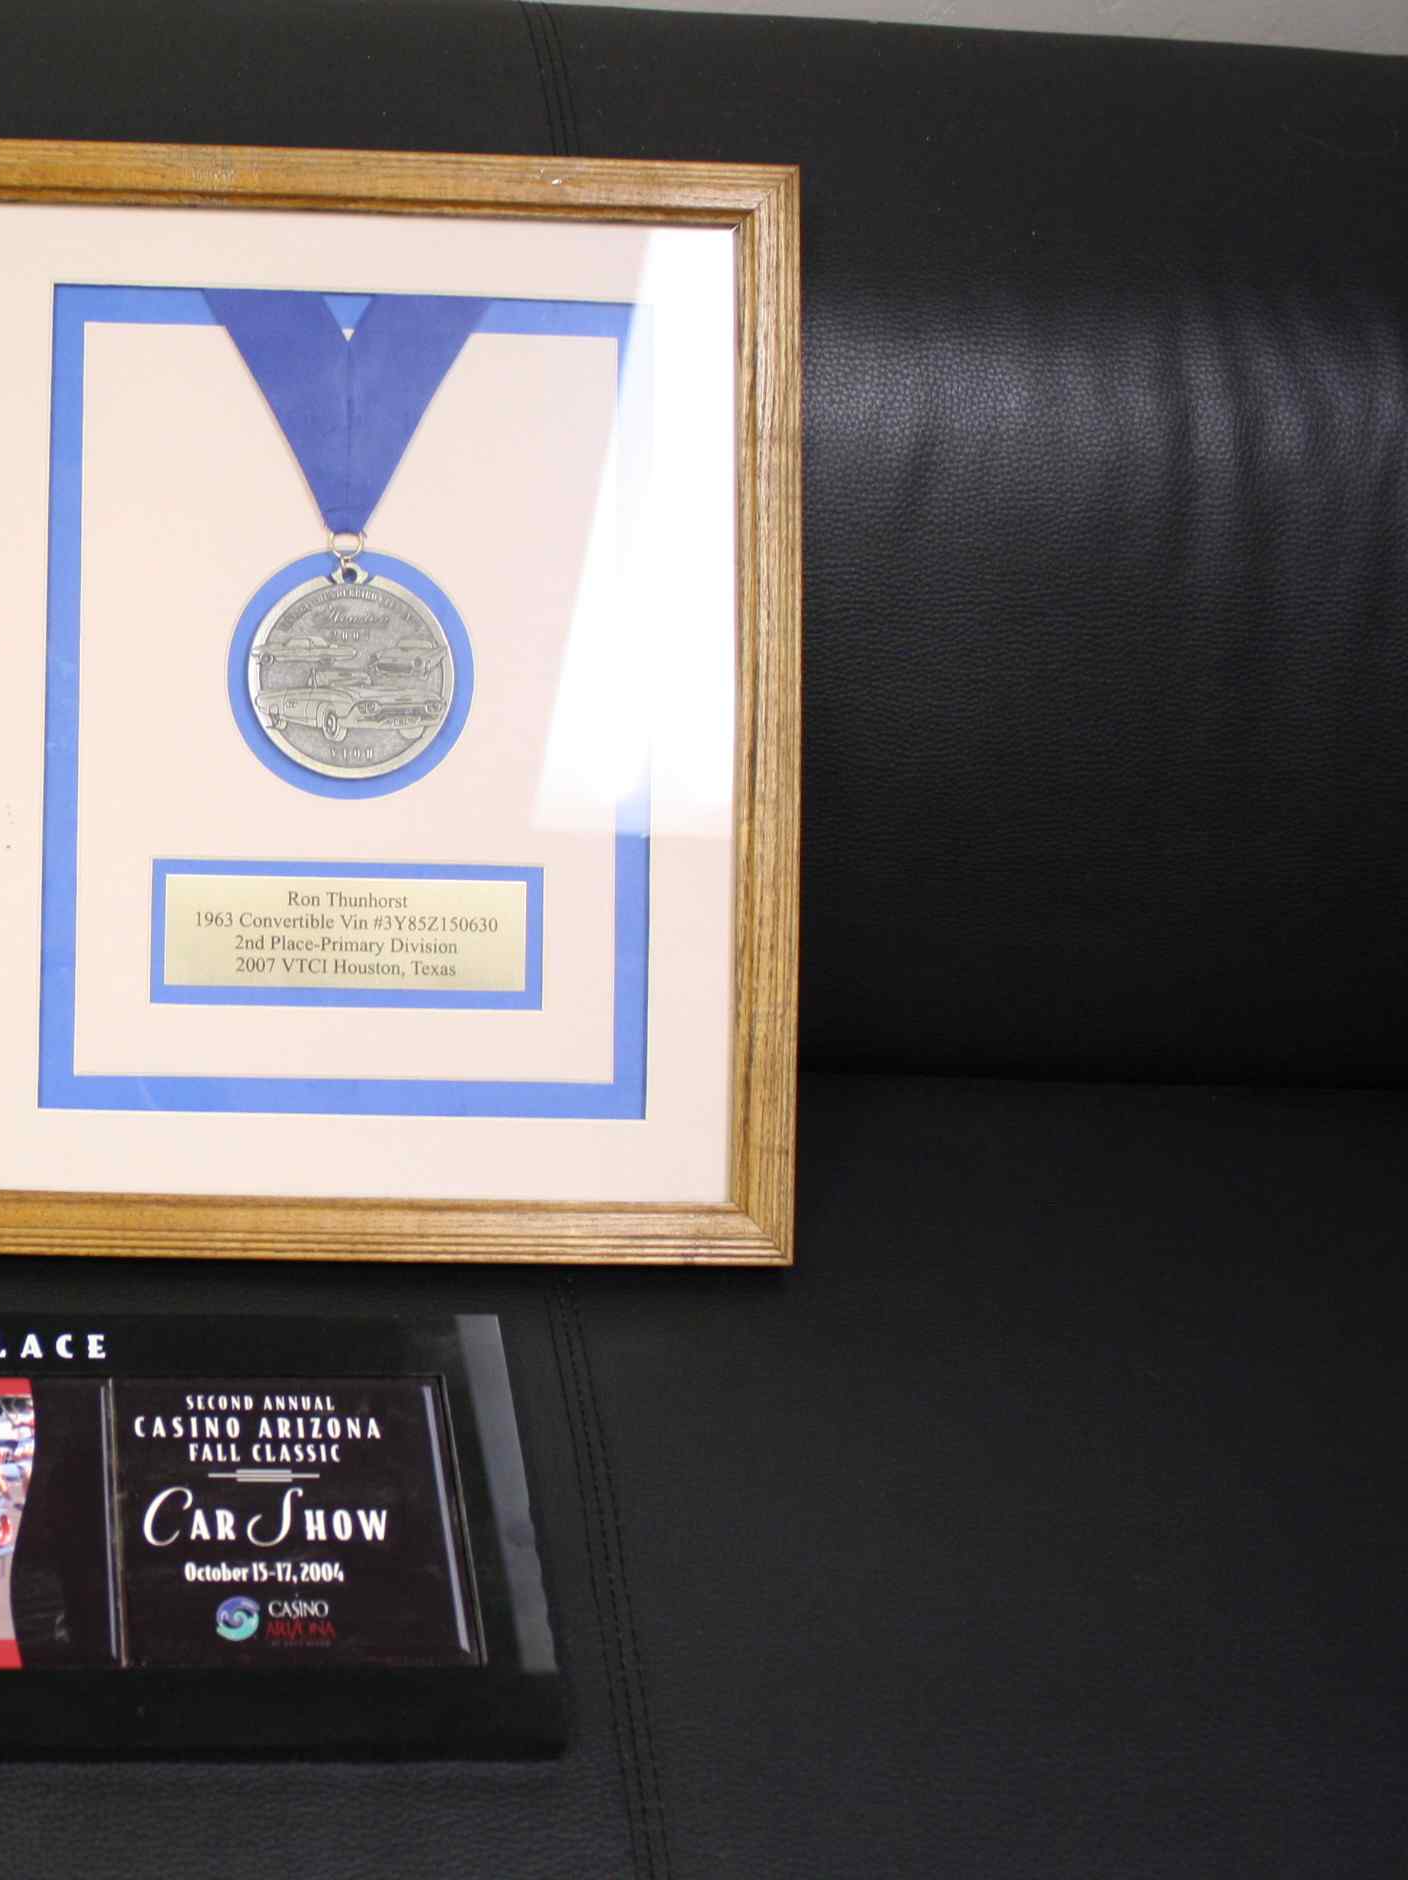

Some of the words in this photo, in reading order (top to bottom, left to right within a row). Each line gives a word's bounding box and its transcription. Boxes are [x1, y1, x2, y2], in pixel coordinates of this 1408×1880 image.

[287, 890, 320, 907] Ron
[326, 891, 408, 909] Thunhorst
[195, 911, 233, 928] 1963
[239, 911, 334, 930] Convertible
[341, 913, 368, 930] Vin
[235, 934, 265, 951] 2nd
[270, 935, 384, 956] Place-Primary
[390, 937, 457, 954] Division
[235, 956, 275, 973] 2007
[333, 958, 405, 978] Houston,
[410, 960, 456, 977] Texas
[186, 1395, 253, 1411] SECOND
[263, 1396, 335, 1411] ANNUAL
[134, 1416, 240, 1438] CASINO
[258, 1417, 381, 1439] ARIZONA
[189, 1444, 241, 1462] FALL
[252, 1444, 341, 1463] CLASSIC
[184, 1562, 249, 1582] October
[252, 1563, 297, 1584] 15-17,
[300, 1563, 345, 1582] 2004
[267, 1598, 329, 1618] CASINO
